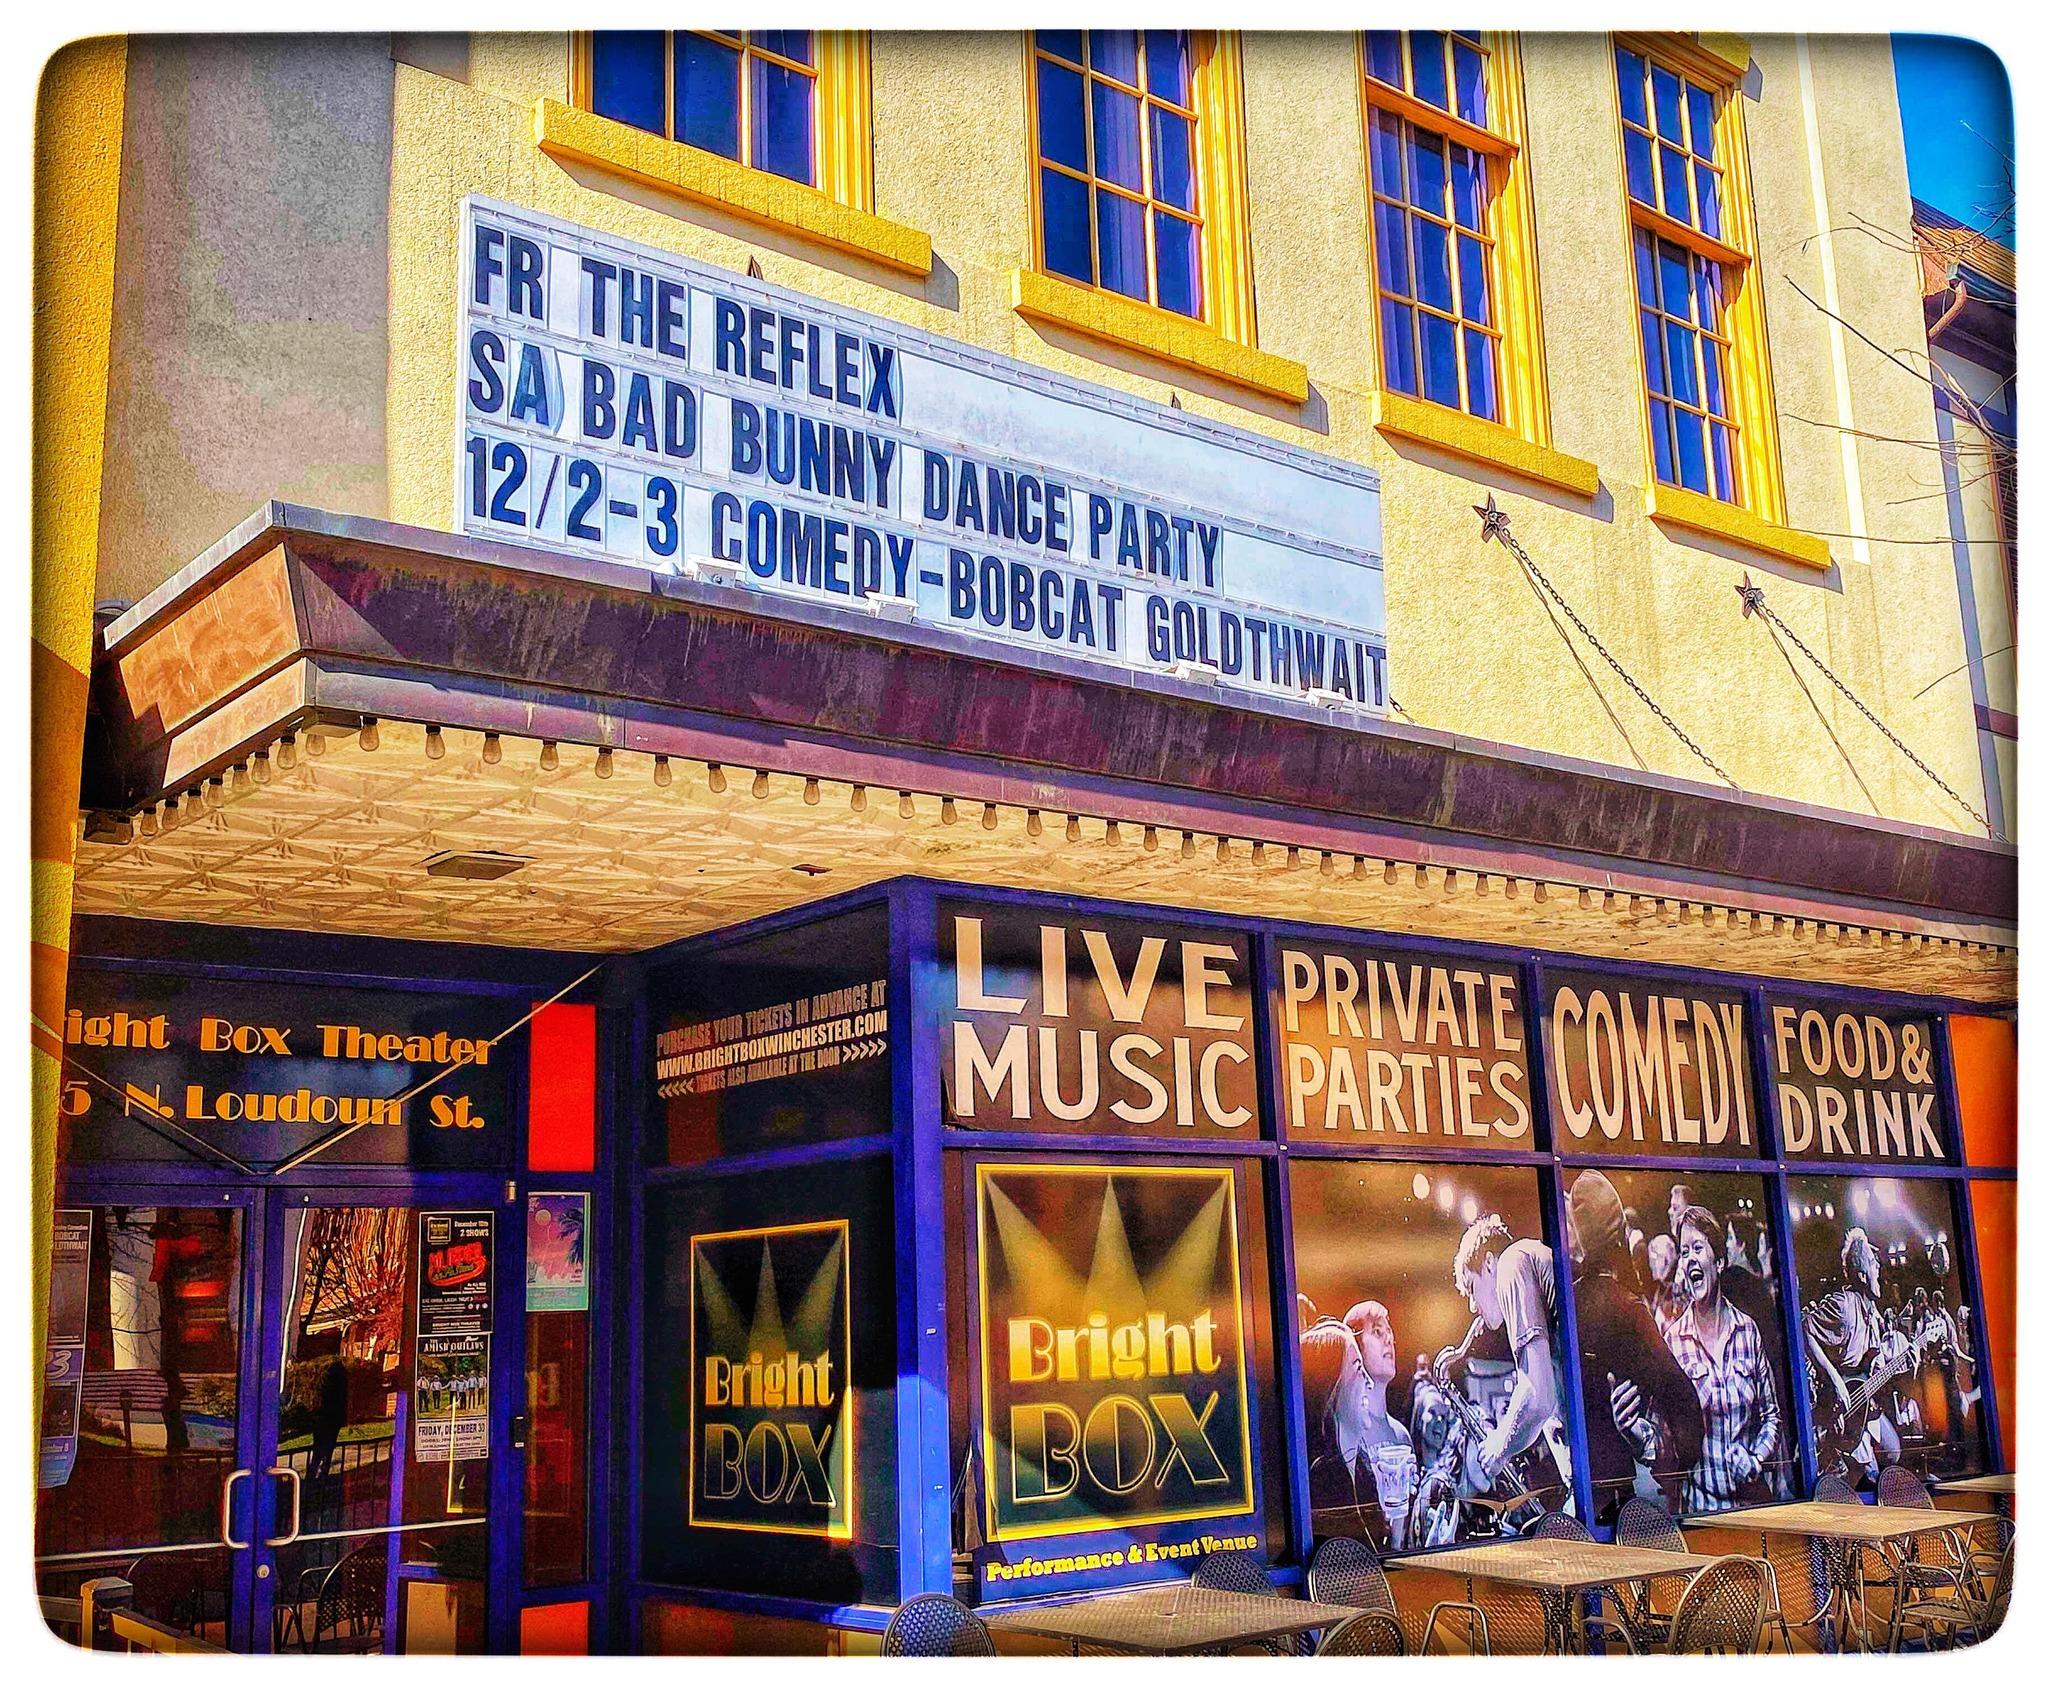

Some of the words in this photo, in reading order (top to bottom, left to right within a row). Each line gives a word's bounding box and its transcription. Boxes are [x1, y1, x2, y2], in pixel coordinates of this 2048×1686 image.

[474, 226, 544, 320] FR
[581, 256, 687, 360] THE
[715, 297, 898, 419] REFLEX
[469, 331, 549, 426] SA
[583, 359, 697, 458] BAD
[731, 399, 897, 508] BUNNY
[923, 449, 1068, 552] DANCE
[1089, 493, 1220, 588] PARTY
[466, 437, 678, 557] 12/2-3
[1146, 595, 1387, 706] GOLDTHWAIT
[954, 916, 1246, 1032] LIVE
[1281, 949, 1523, 1052] PRIVATE
[64, 1009, 170, 1050] ight
[200, 1017, 292, 1055] Box
[316, 1022, 497, 1065] Theater
[656, 1022, 711, 1056] PURCHASE
[713, 1015, 743, 1043] YOUR
[746, 1002, 792, 1035] TICKETS
[796, 998, 809, 1024] IN
[812, 984, 868, 1021] ADVANCE
[871, 980, 886, 1007] AT
[657, 1010, 887, 1080] WWW.BRIGHTBOXWINCHESTER.COM
[61, 1080, 91, 1116] 5
[185, 1085, 402, 1126] Loudoun
[429, 1095, 485, 1128] St.
[697, 1070, 726, 1093] TICKETS
[727, 1066, 746, 1087] ALSO
[747, 1057, 787, 1082] AVAILABLE
[788, 1054, 798, 1074] AT
[800, 1051, 815, 1072] THE
[818, 1046, 840, 1068] DOOR
[953, 1021, 1254, 1127] MUSIC
[1286, 1042, 1530, 1138] PARTIES
[1552, 986, 1752, 1146] COMEDY
[1778, 1084, 1945, 1158] DRINK
[54, 1241, 88, 1250] LDTHWAIT
[704, 1350, 835, 1409] Bright
[1008, 1309, 1222, 1382] Bright
[704, 1421, 837, 1509] BOX
[1010, 1391, 1231, 1504] BOX
[986, 1551, 1125, 1582] Performance
[1127, 1544, 1144, 1565] &
[1144, 1538, 1200, 1562] Event
[1199, 1534, 1258, 1554] Venue
